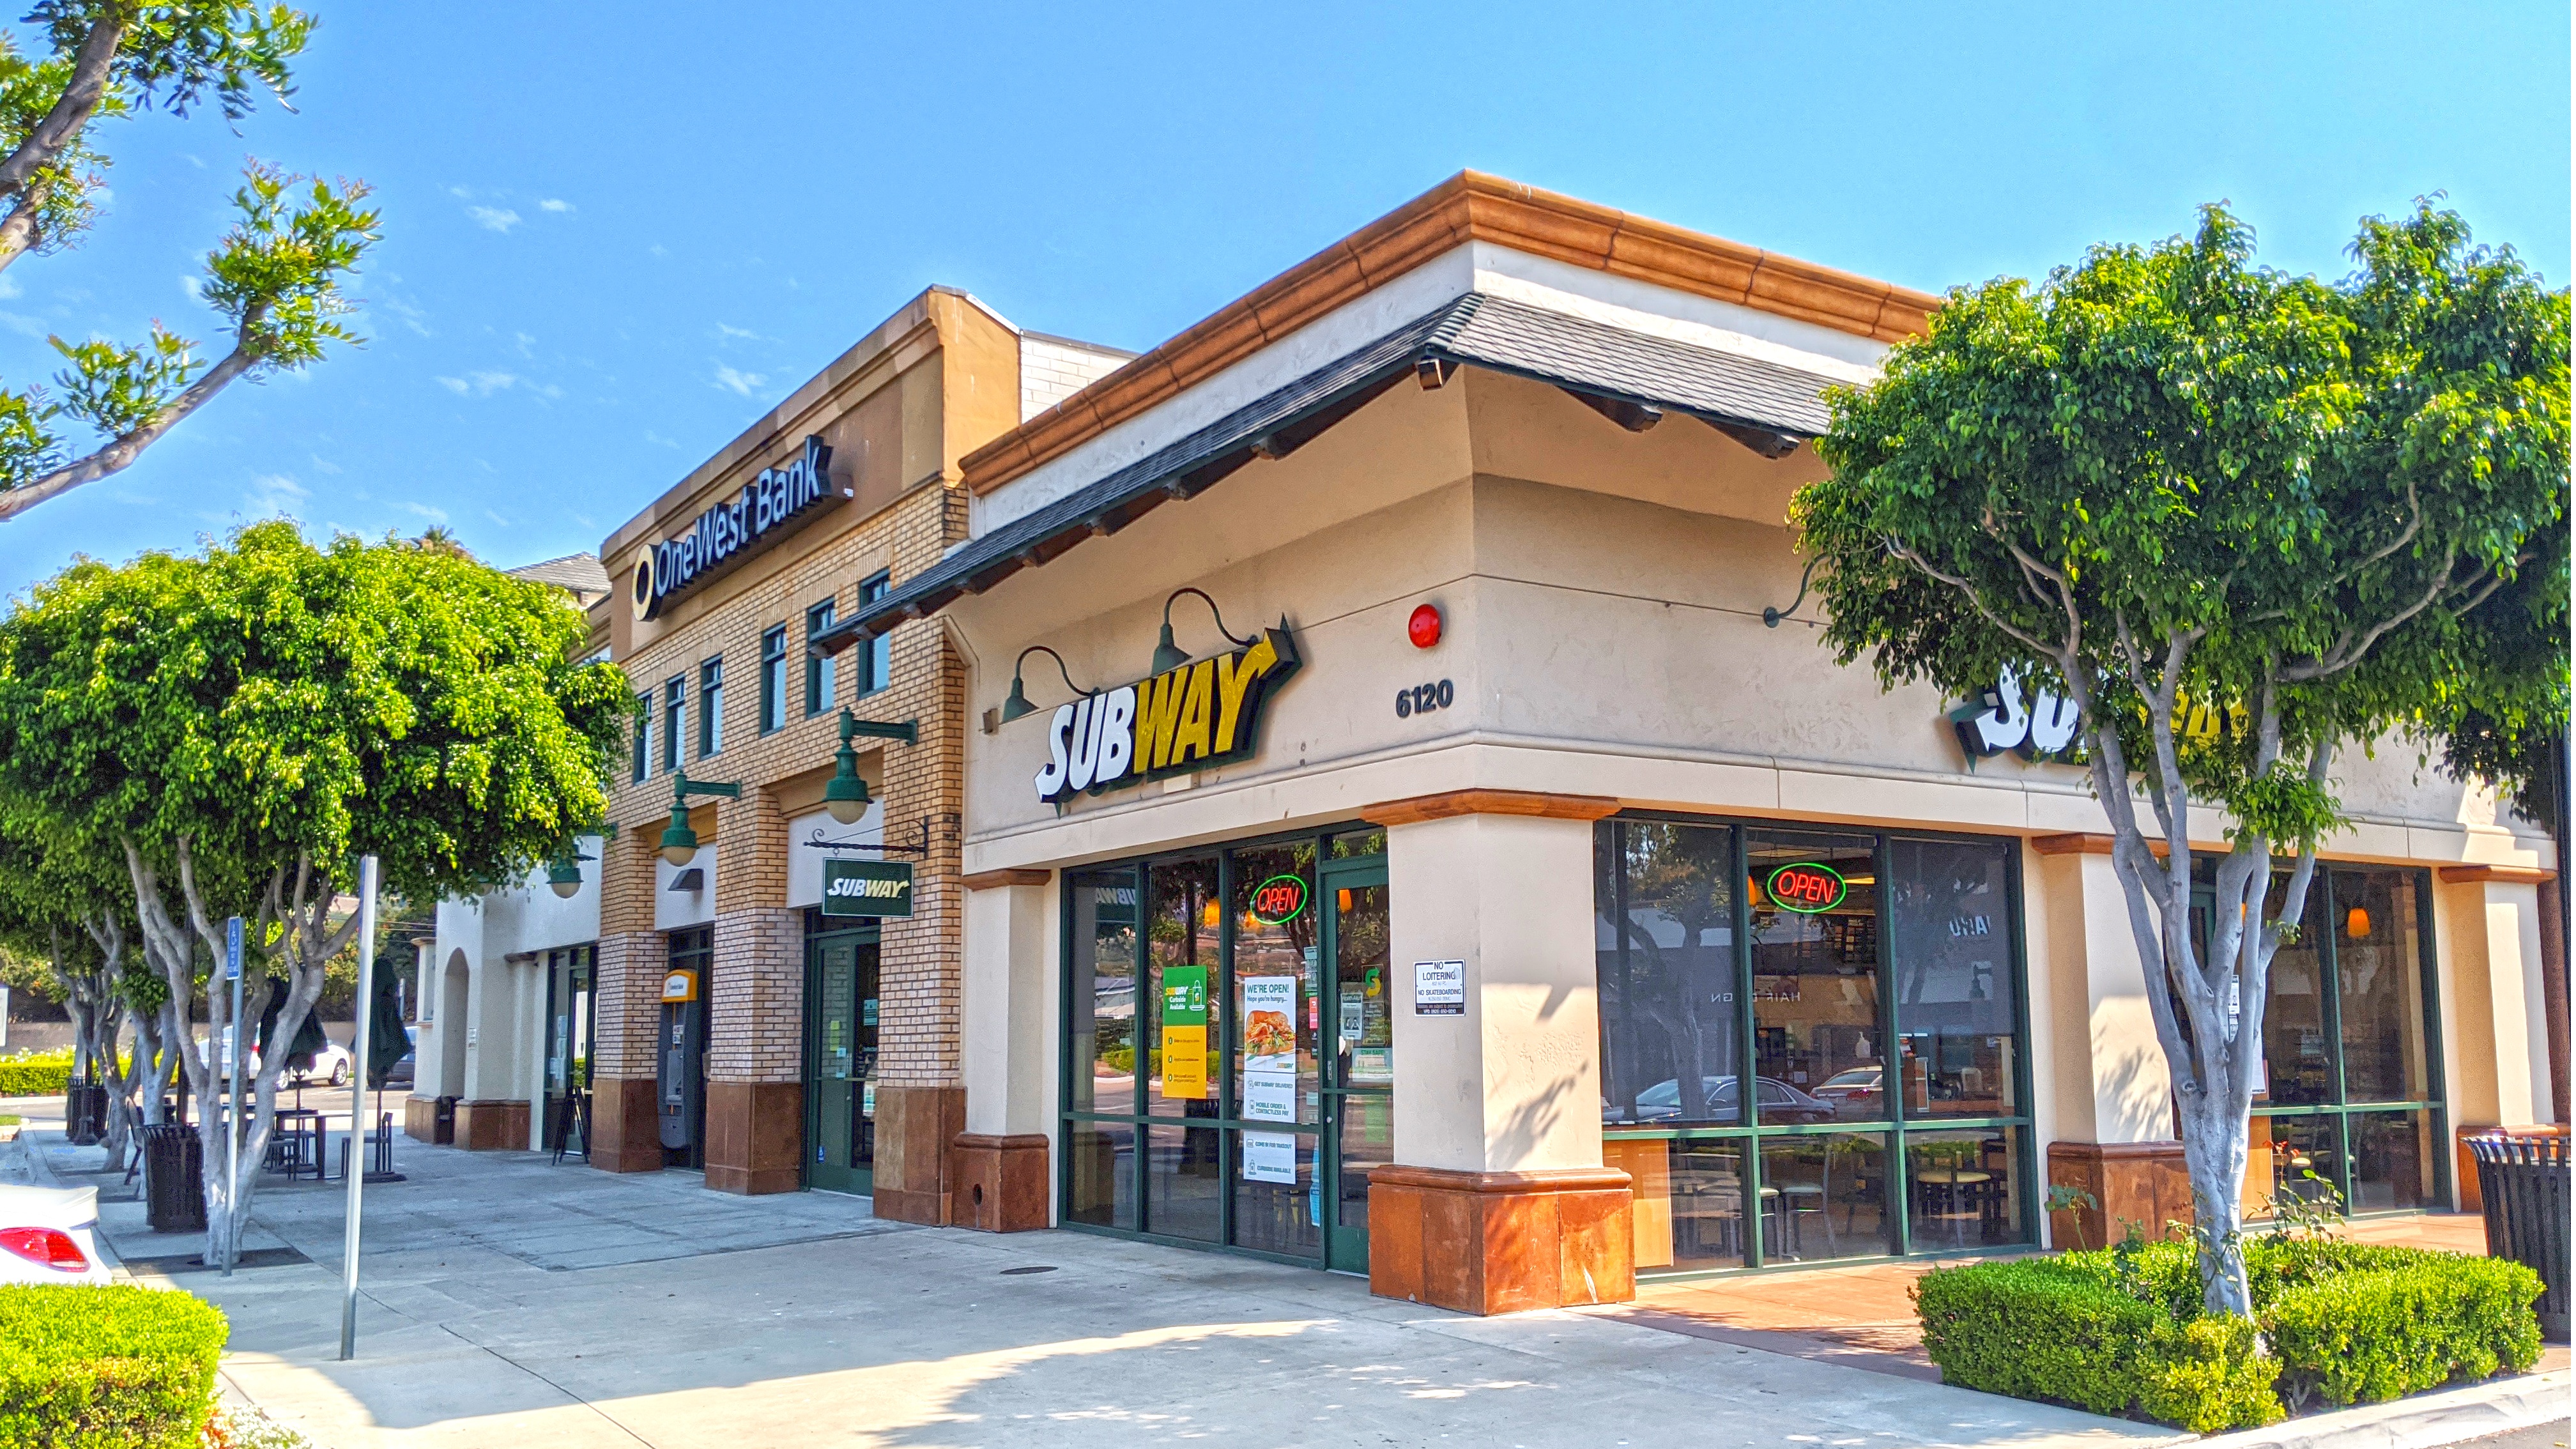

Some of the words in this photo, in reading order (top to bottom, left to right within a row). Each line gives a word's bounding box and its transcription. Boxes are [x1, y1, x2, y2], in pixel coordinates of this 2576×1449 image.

[656, 486, 751, 597] OneWest
[756, 434, 821, 535] Bank
[1396, 678, 1453, 718] 6120
[1034, 629, 1278, 797] SUBWAY
[827, 878, 910, 898] SUBWAY
[1778, 871, 1836, 903] OPEN
[1257, 887, 1299, 912] OPEN
[1422, 971, 1456, 981] LOITERING
[1434, 962, 1444, 970] NO
[1165, 986, 1188, 995] SUBWAY
[1246, 984, 1268, 993] WE'RE
[1269, 984, 1289, 993] OPEN!
